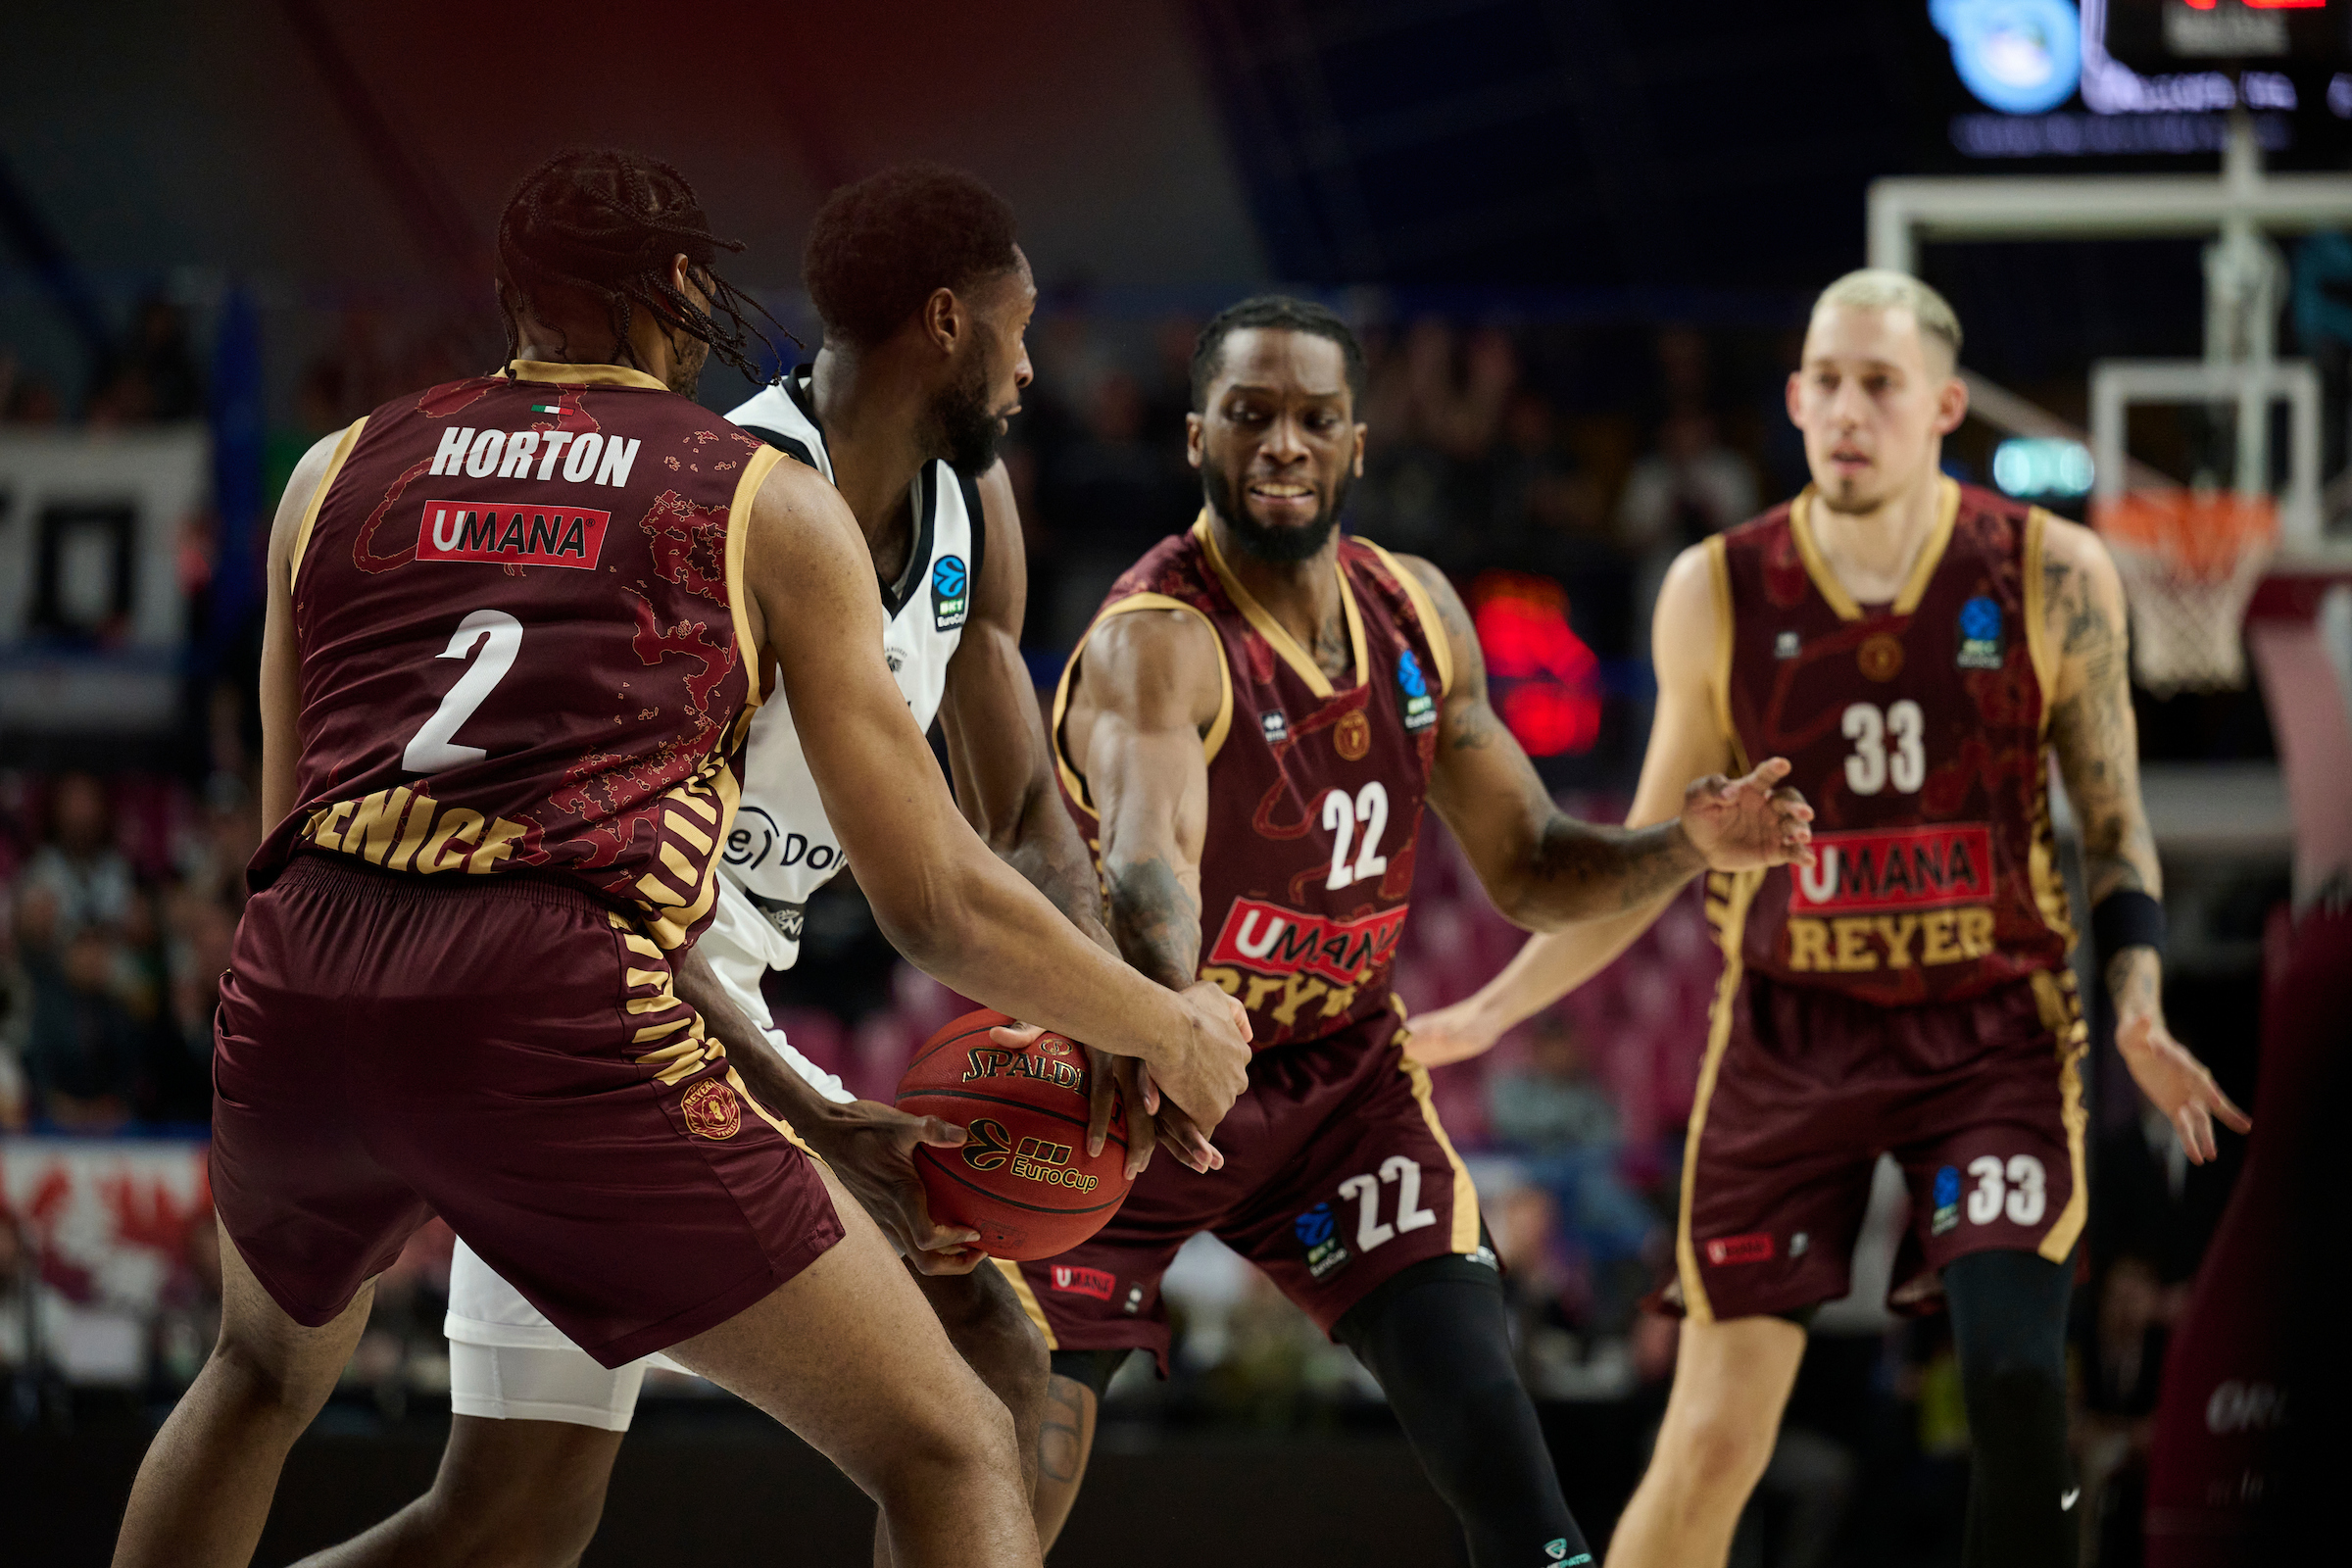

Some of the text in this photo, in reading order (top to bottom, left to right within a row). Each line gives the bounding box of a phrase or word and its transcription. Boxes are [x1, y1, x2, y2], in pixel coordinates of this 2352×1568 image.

[428, 426, 642, 488] HORTON
[939, 597, 964, 615] BKT
[401, 609, 524, 774] 2
[1841, 699, 1926, 796] 33
[1322, 781, 1389, 891] 22
[1799, 839, 1980, 905] UMANA
[1787, 906, 1996, 972] REYER
[684, 1081, 713, 1107] REYER
[715, 1117, 739, 1137] VENEZIA
[1010, 1155, 1100, 1195] EuroCup
[1015, 1137, 1073, 1166] BKT
[1337, 1154, 1438, 1253] 22
[1966, 1153, 2047, 1226] 33
